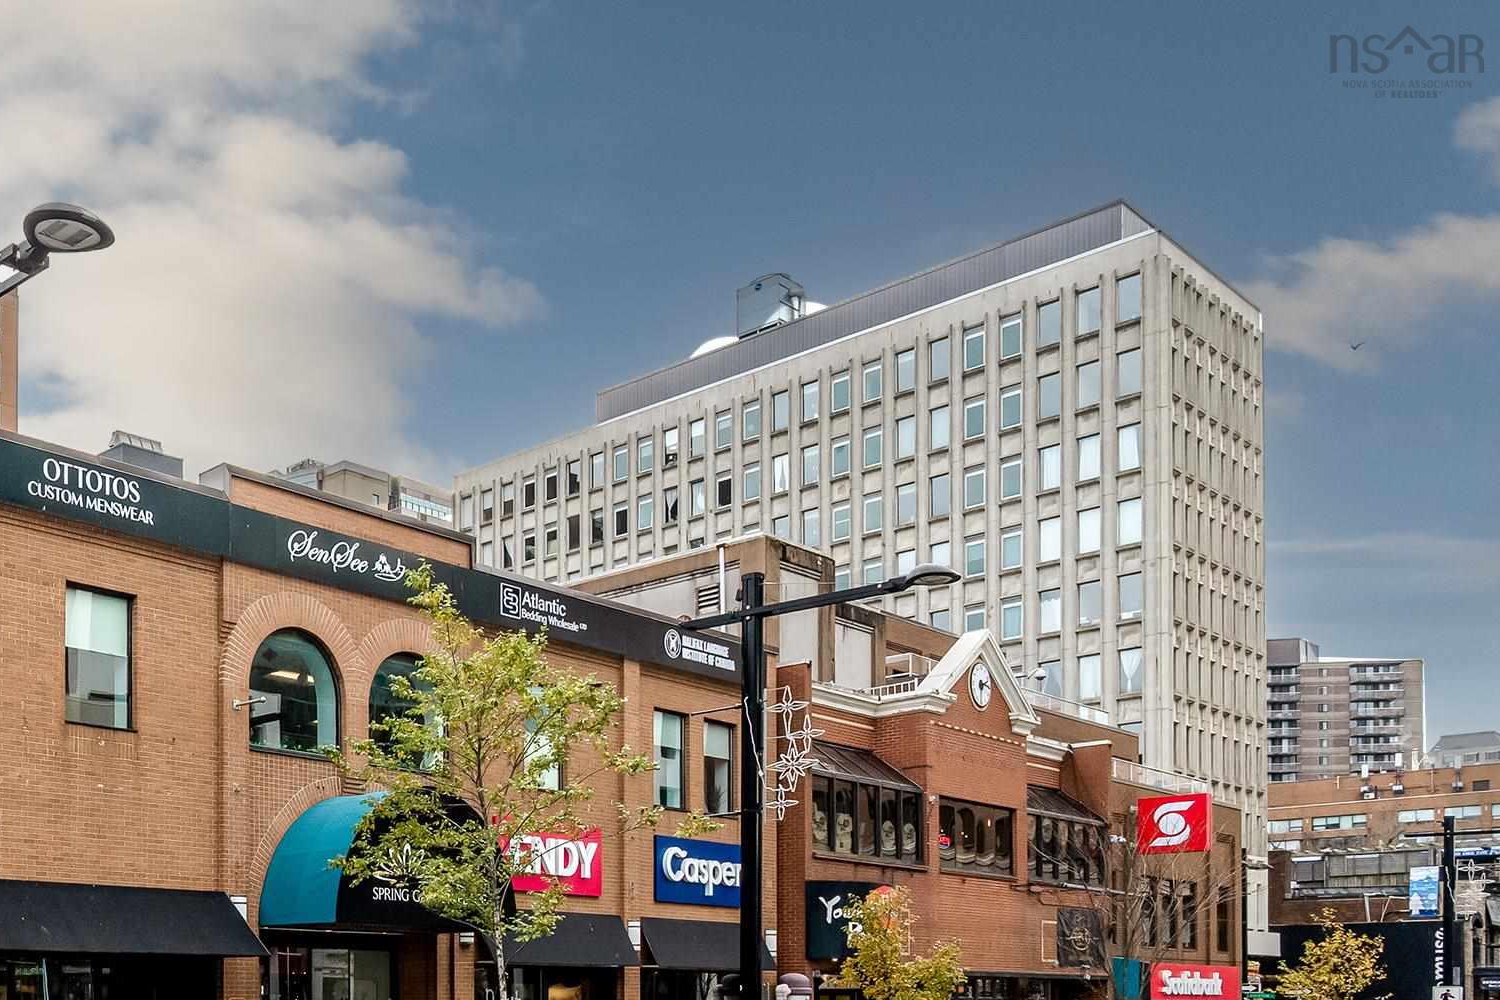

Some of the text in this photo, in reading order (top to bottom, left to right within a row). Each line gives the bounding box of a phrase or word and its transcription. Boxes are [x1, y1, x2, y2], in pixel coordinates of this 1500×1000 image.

[43, 458, 141, 503] OTTOTOS
[27, 480, 155, 526] CUSTOM MENSWEAR
[287, 529, 369, 573] SenSee
[522, 591, 567, 616] Atlantic
[522, 608, 548, 625] Bedding
[548, 615, 579, 633] Wholesale
[372, 886, 410, 902] SPRING
[1159, 969, 1223, 996] Scotiabank
